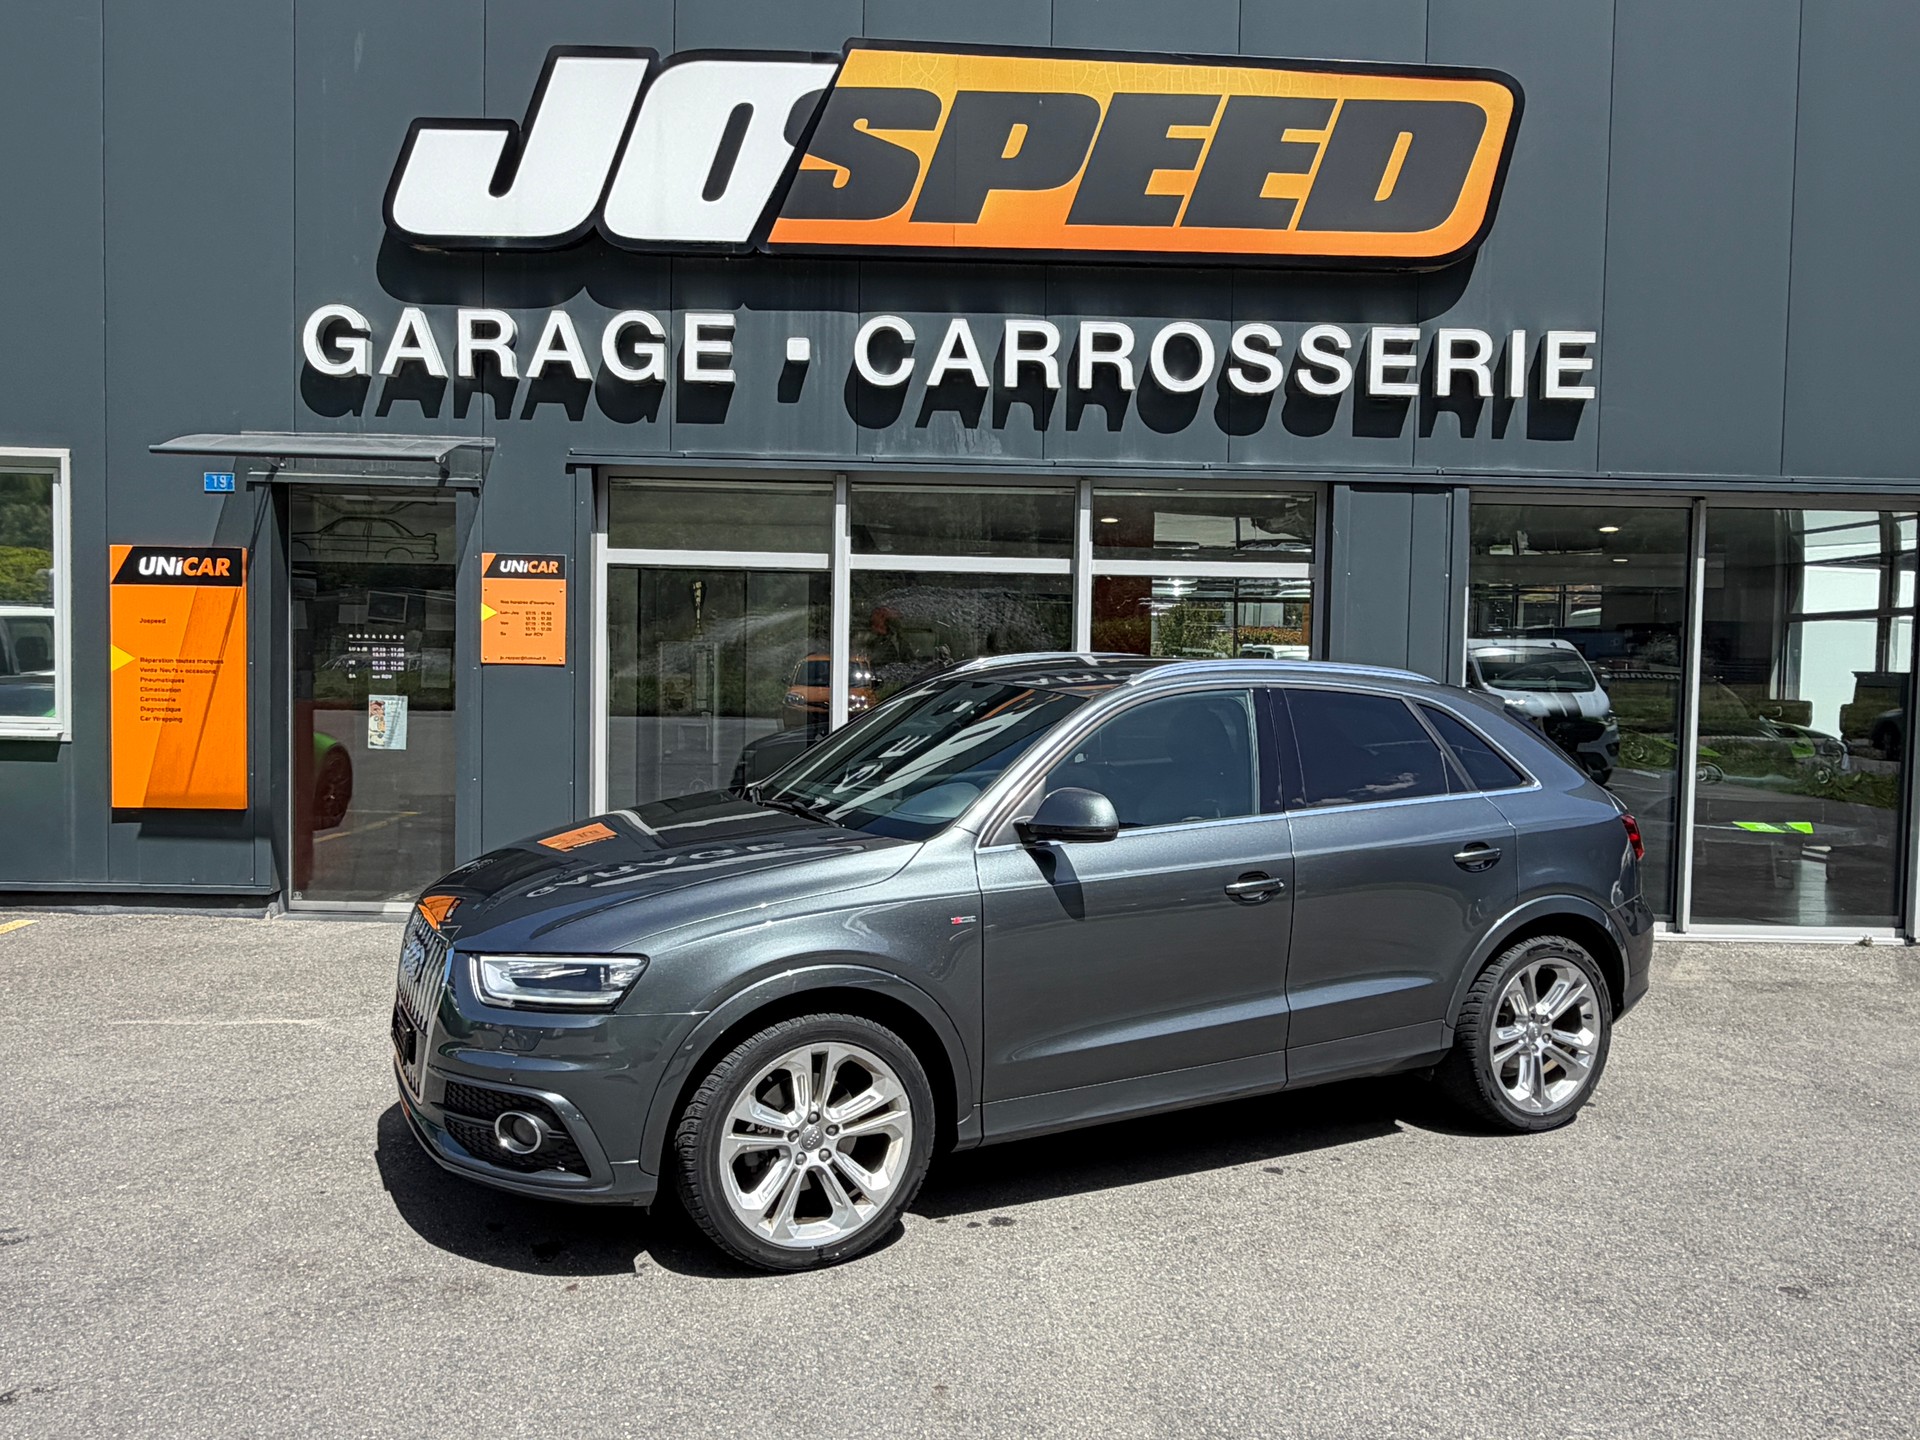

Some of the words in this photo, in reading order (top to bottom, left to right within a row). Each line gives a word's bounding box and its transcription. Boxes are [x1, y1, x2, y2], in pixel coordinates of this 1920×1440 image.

[301, 303, 737, 388] GARAGE
[852, 314, 1598, 404] CARROSSERIE
[211, 474, 228, 489] 19
[139, 617, 167, 625] Jospeed
